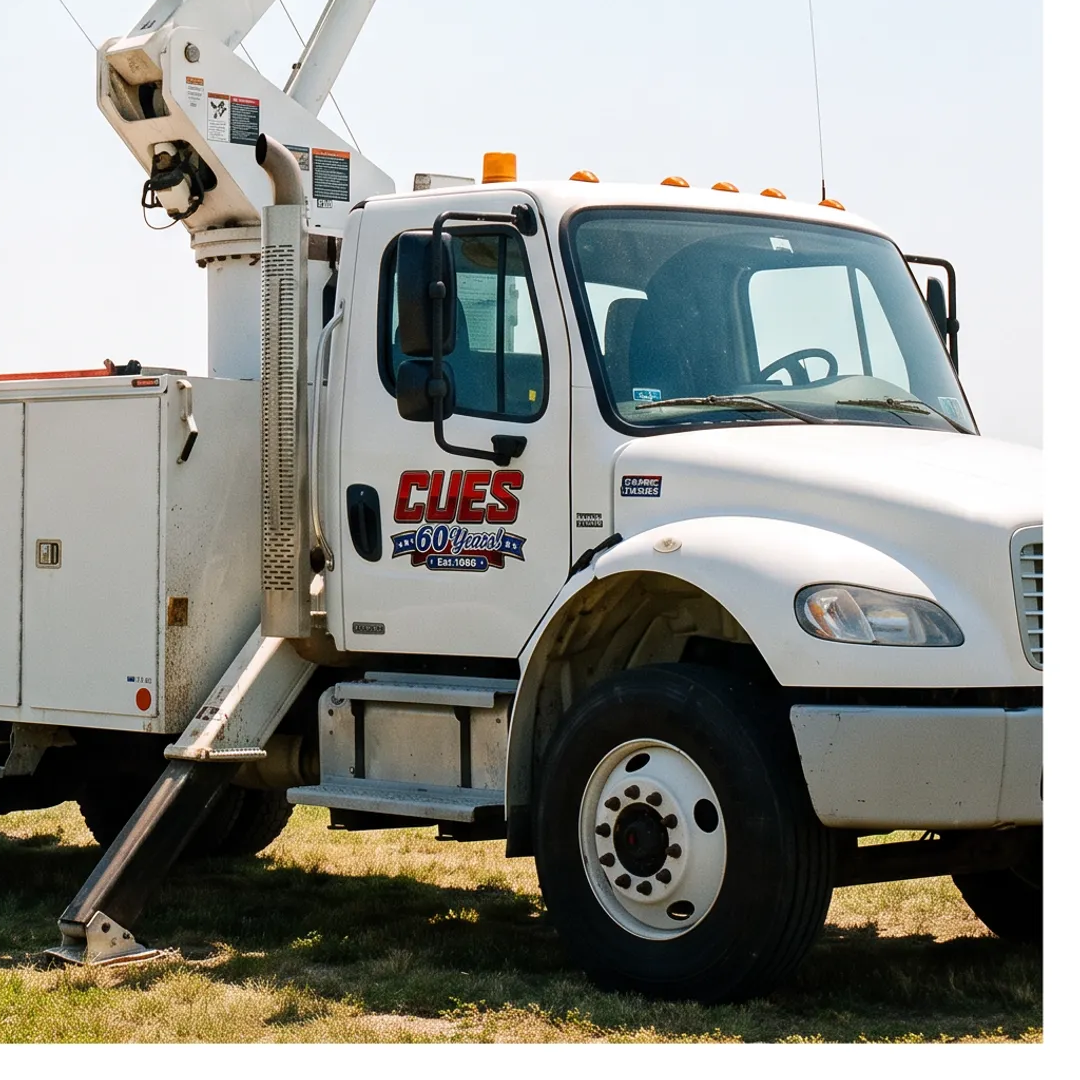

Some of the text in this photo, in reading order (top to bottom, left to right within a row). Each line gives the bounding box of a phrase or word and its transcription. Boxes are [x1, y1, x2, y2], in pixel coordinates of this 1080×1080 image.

[393, 470, 525, 524] CUES
[415, 524, 506, 555] 60 Years!
